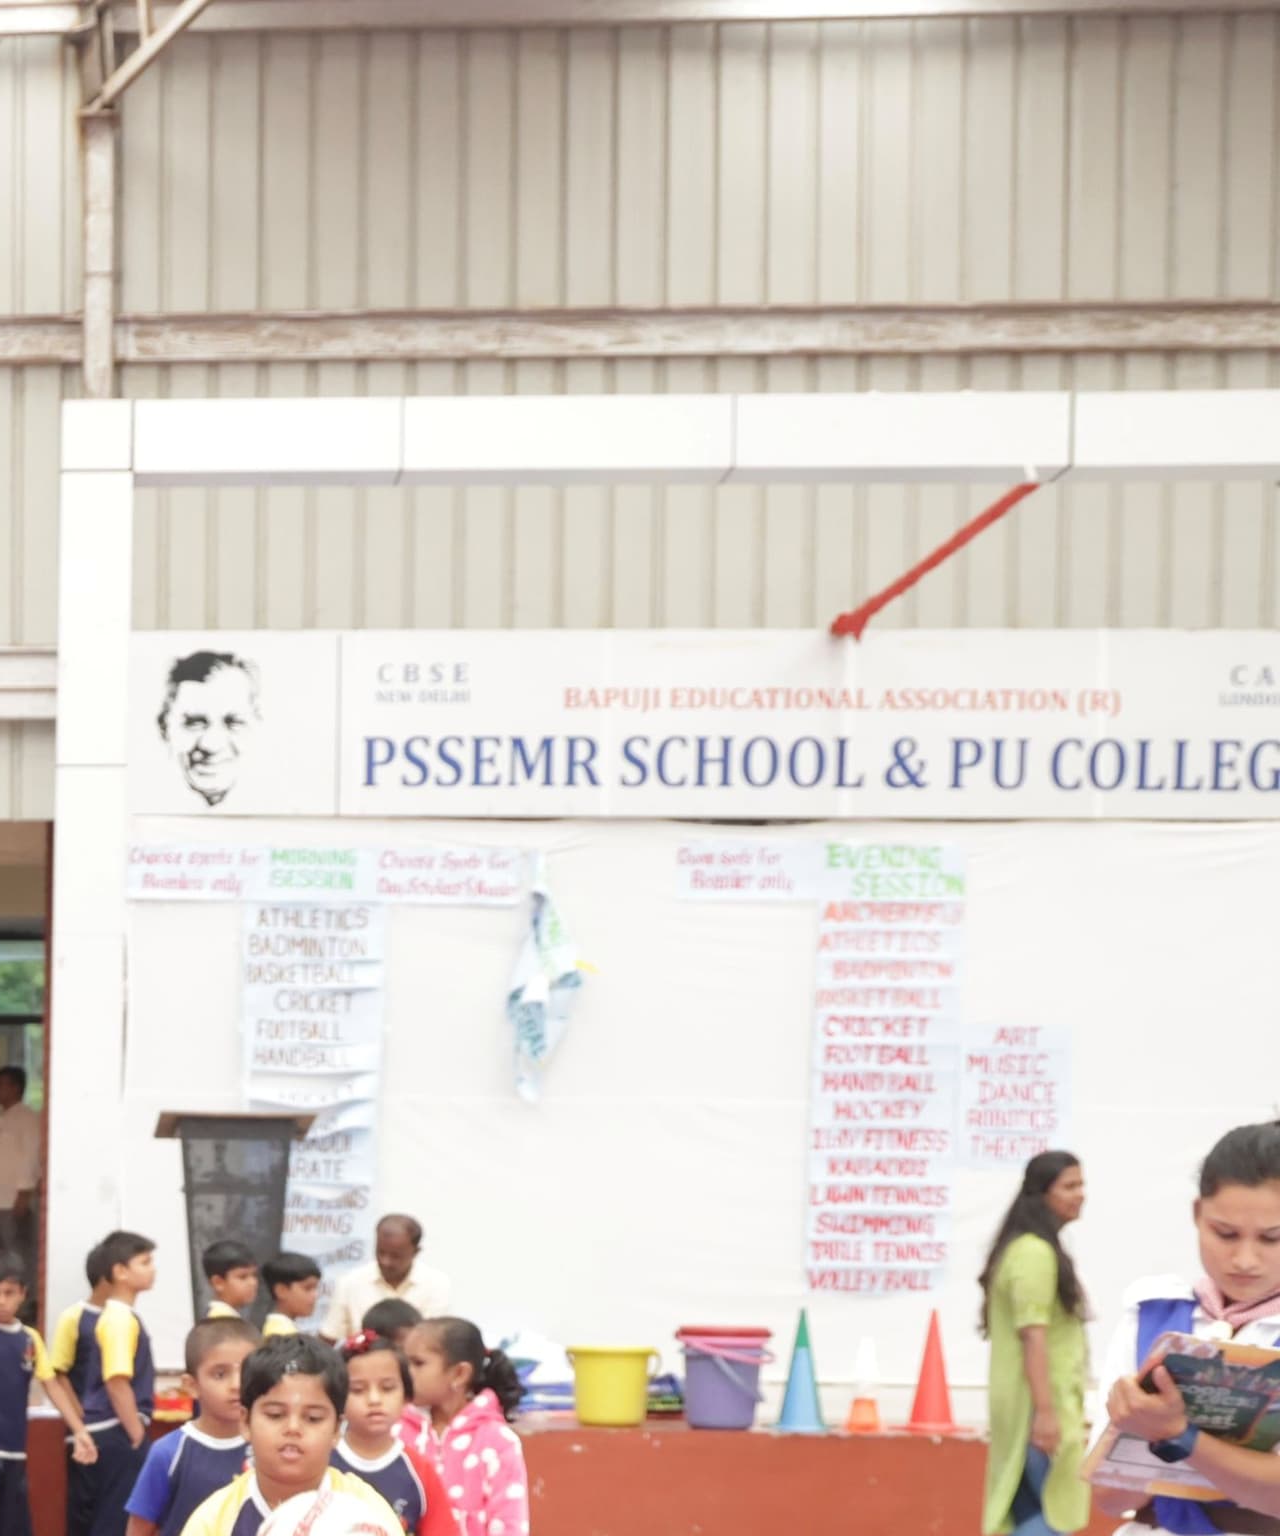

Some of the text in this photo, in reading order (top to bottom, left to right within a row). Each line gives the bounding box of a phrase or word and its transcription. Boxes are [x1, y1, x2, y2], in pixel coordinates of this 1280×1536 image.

[375, 688, 471, 704] NEW DELHI
[562, 686, 1123, 718] BAPUJI EDUCATIONAL ASSOCIATION (R)
[362, 735, 1280, 794] PSSEMR SCHOOL & PU COLLEG
[824, 842, 942, 870] EVENING
[256, 906, 370, 930] ATHLETICS
[247, 933, 368, 957] BADMINTON
[245, 961, 360, 985] BASKETBALL
[272, 988, 354, 1014] CRICKET
[821, 1015, 932, 1038] CRICKET
[992, 1024, 1043, 1048] ART
[966, 1053, 1049, 1076] MUSIC
[977, 1080, 1057, 1106] DANCE
[832, 1100, 927, 1121] HOCKEY
[815, 1212, 935, 1237] SWIMMING
